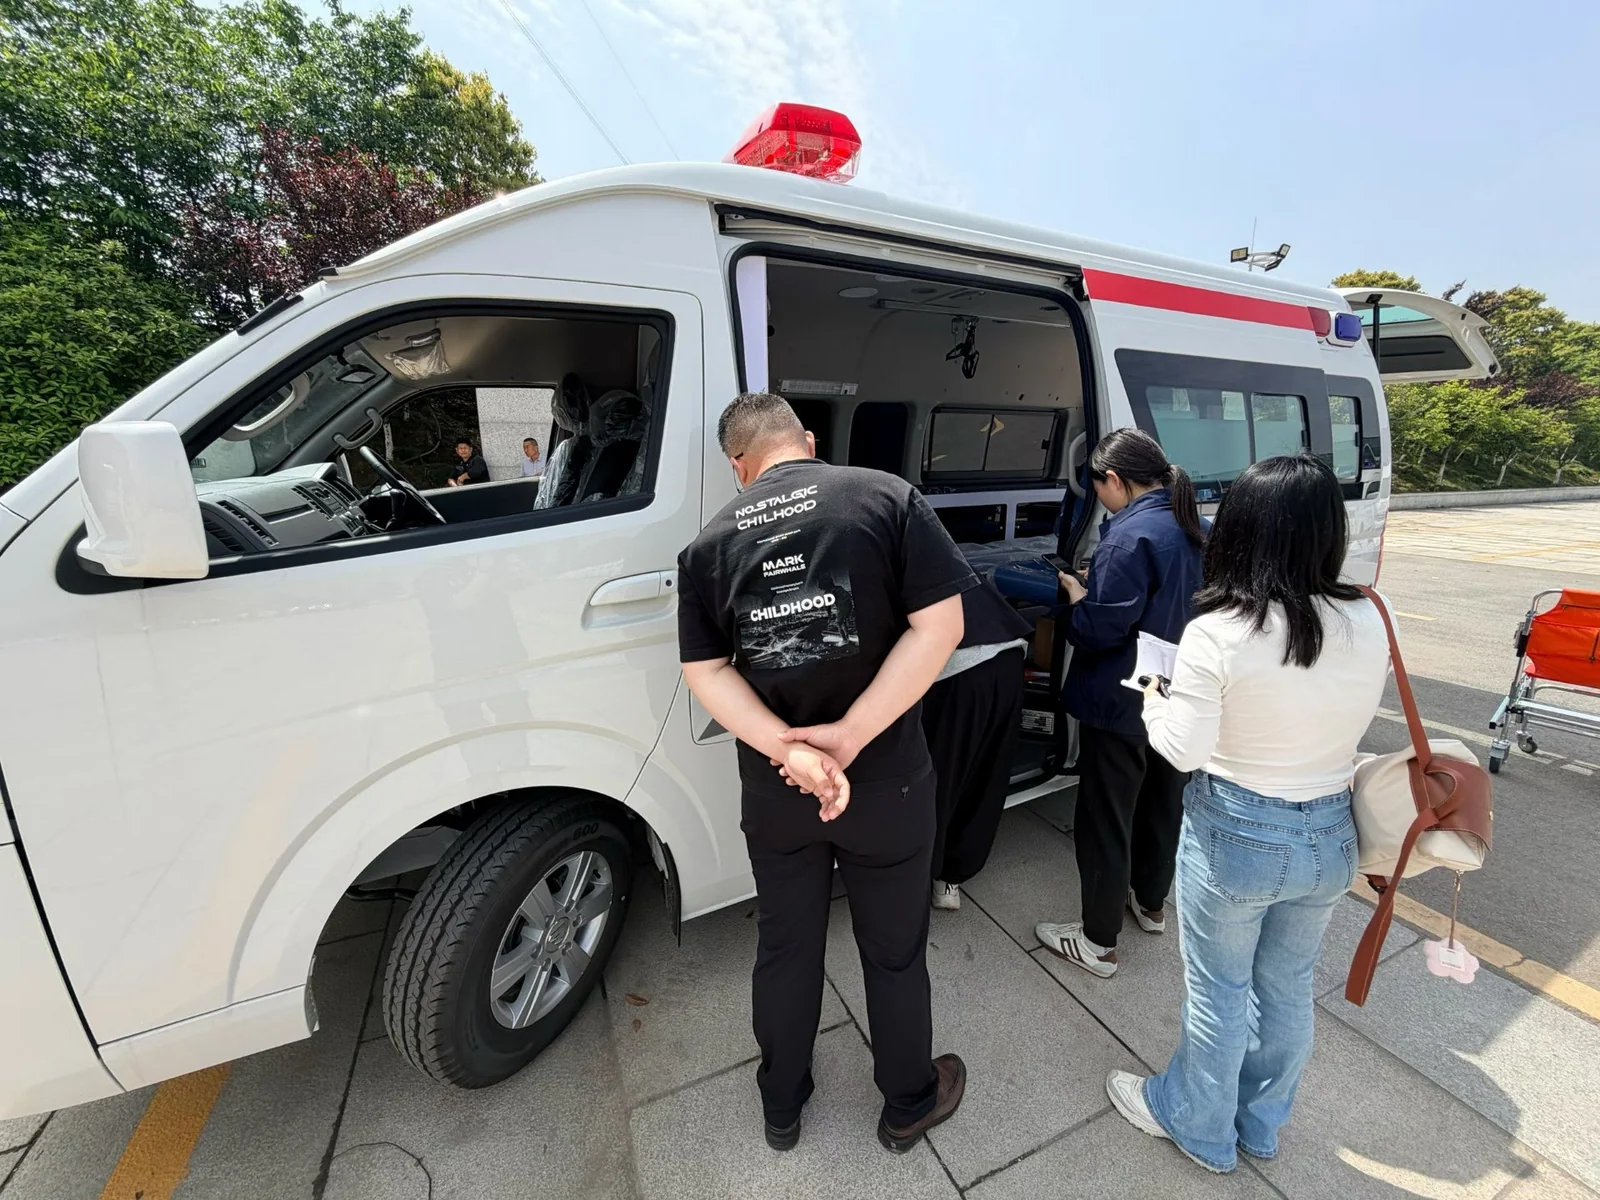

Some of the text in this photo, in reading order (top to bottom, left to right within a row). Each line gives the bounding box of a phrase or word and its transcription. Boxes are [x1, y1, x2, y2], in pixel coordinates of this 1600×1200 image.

[735, 485, 818, 519] NOSTALGIC
[737, 500, 816, 530] CHILHOOD
[762, 553, 804, 571] MARK
[750, 593, 836, 622] CHILDHOOD
